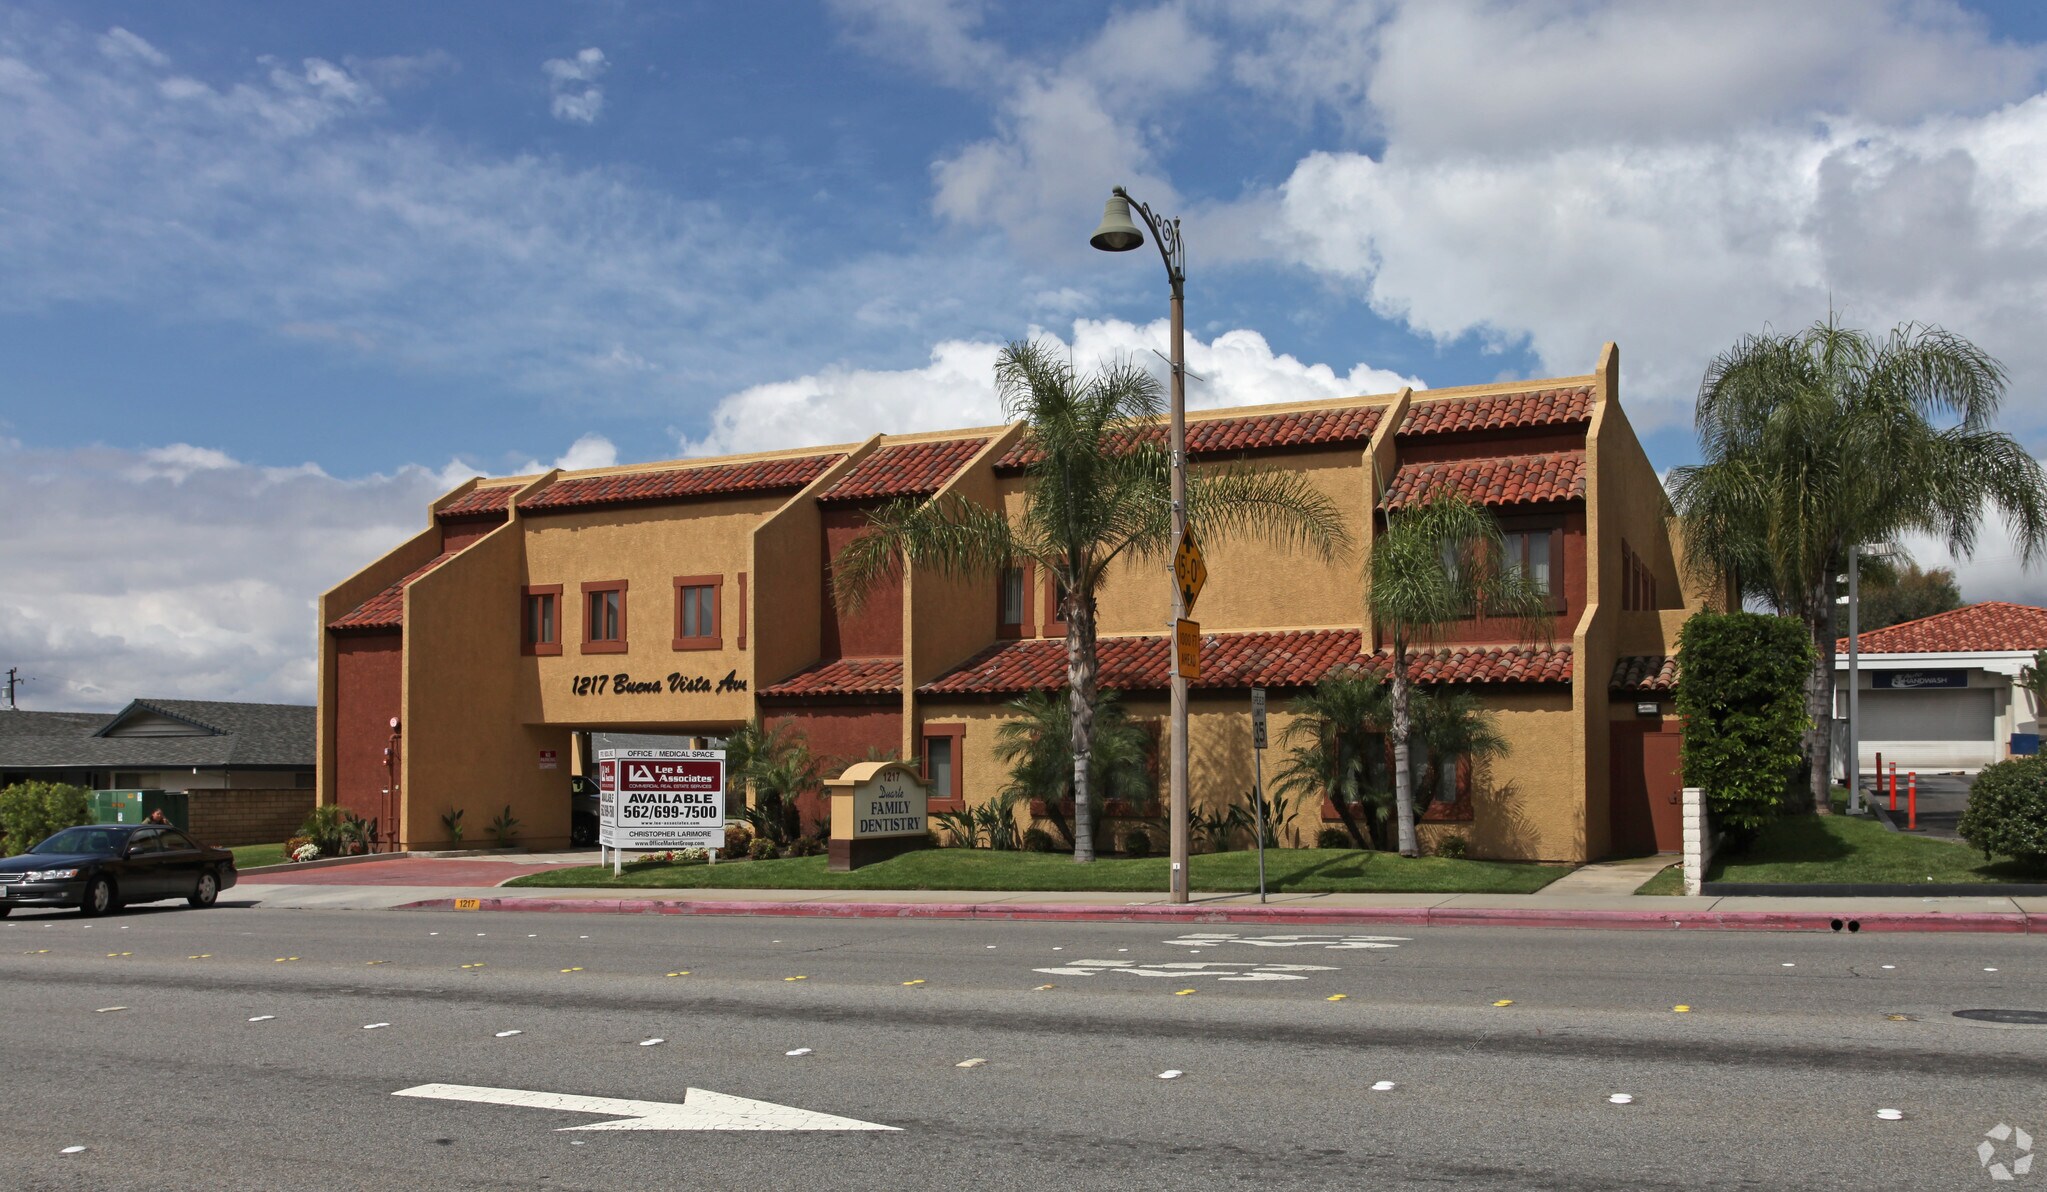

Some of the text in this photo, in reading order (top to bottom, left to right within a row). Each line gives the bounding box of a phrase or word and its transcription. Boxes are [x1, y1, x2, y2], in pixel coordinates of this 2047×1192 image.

[572, 674, 609, 696] 1217
[613, 673, 662, 695] Buena
[667, 672, 712, 693] Vista
[1254, 721, 1265, 743] 35
[655, 765, 684, 774] Lee &
[658, 774, 713, 783] Associates
[883, 772, 900, 783] 1217
[628, 793, 713, 804] AVAILABLE
[878, 785, 904, 799] Duarte
[623, 805, 717, 819] 562/699-7500
[870, 801, 911, 815] FAMILY
[860, 817, 921, 833] DENTISTRY
[459, 899, 476, 908] 1217
